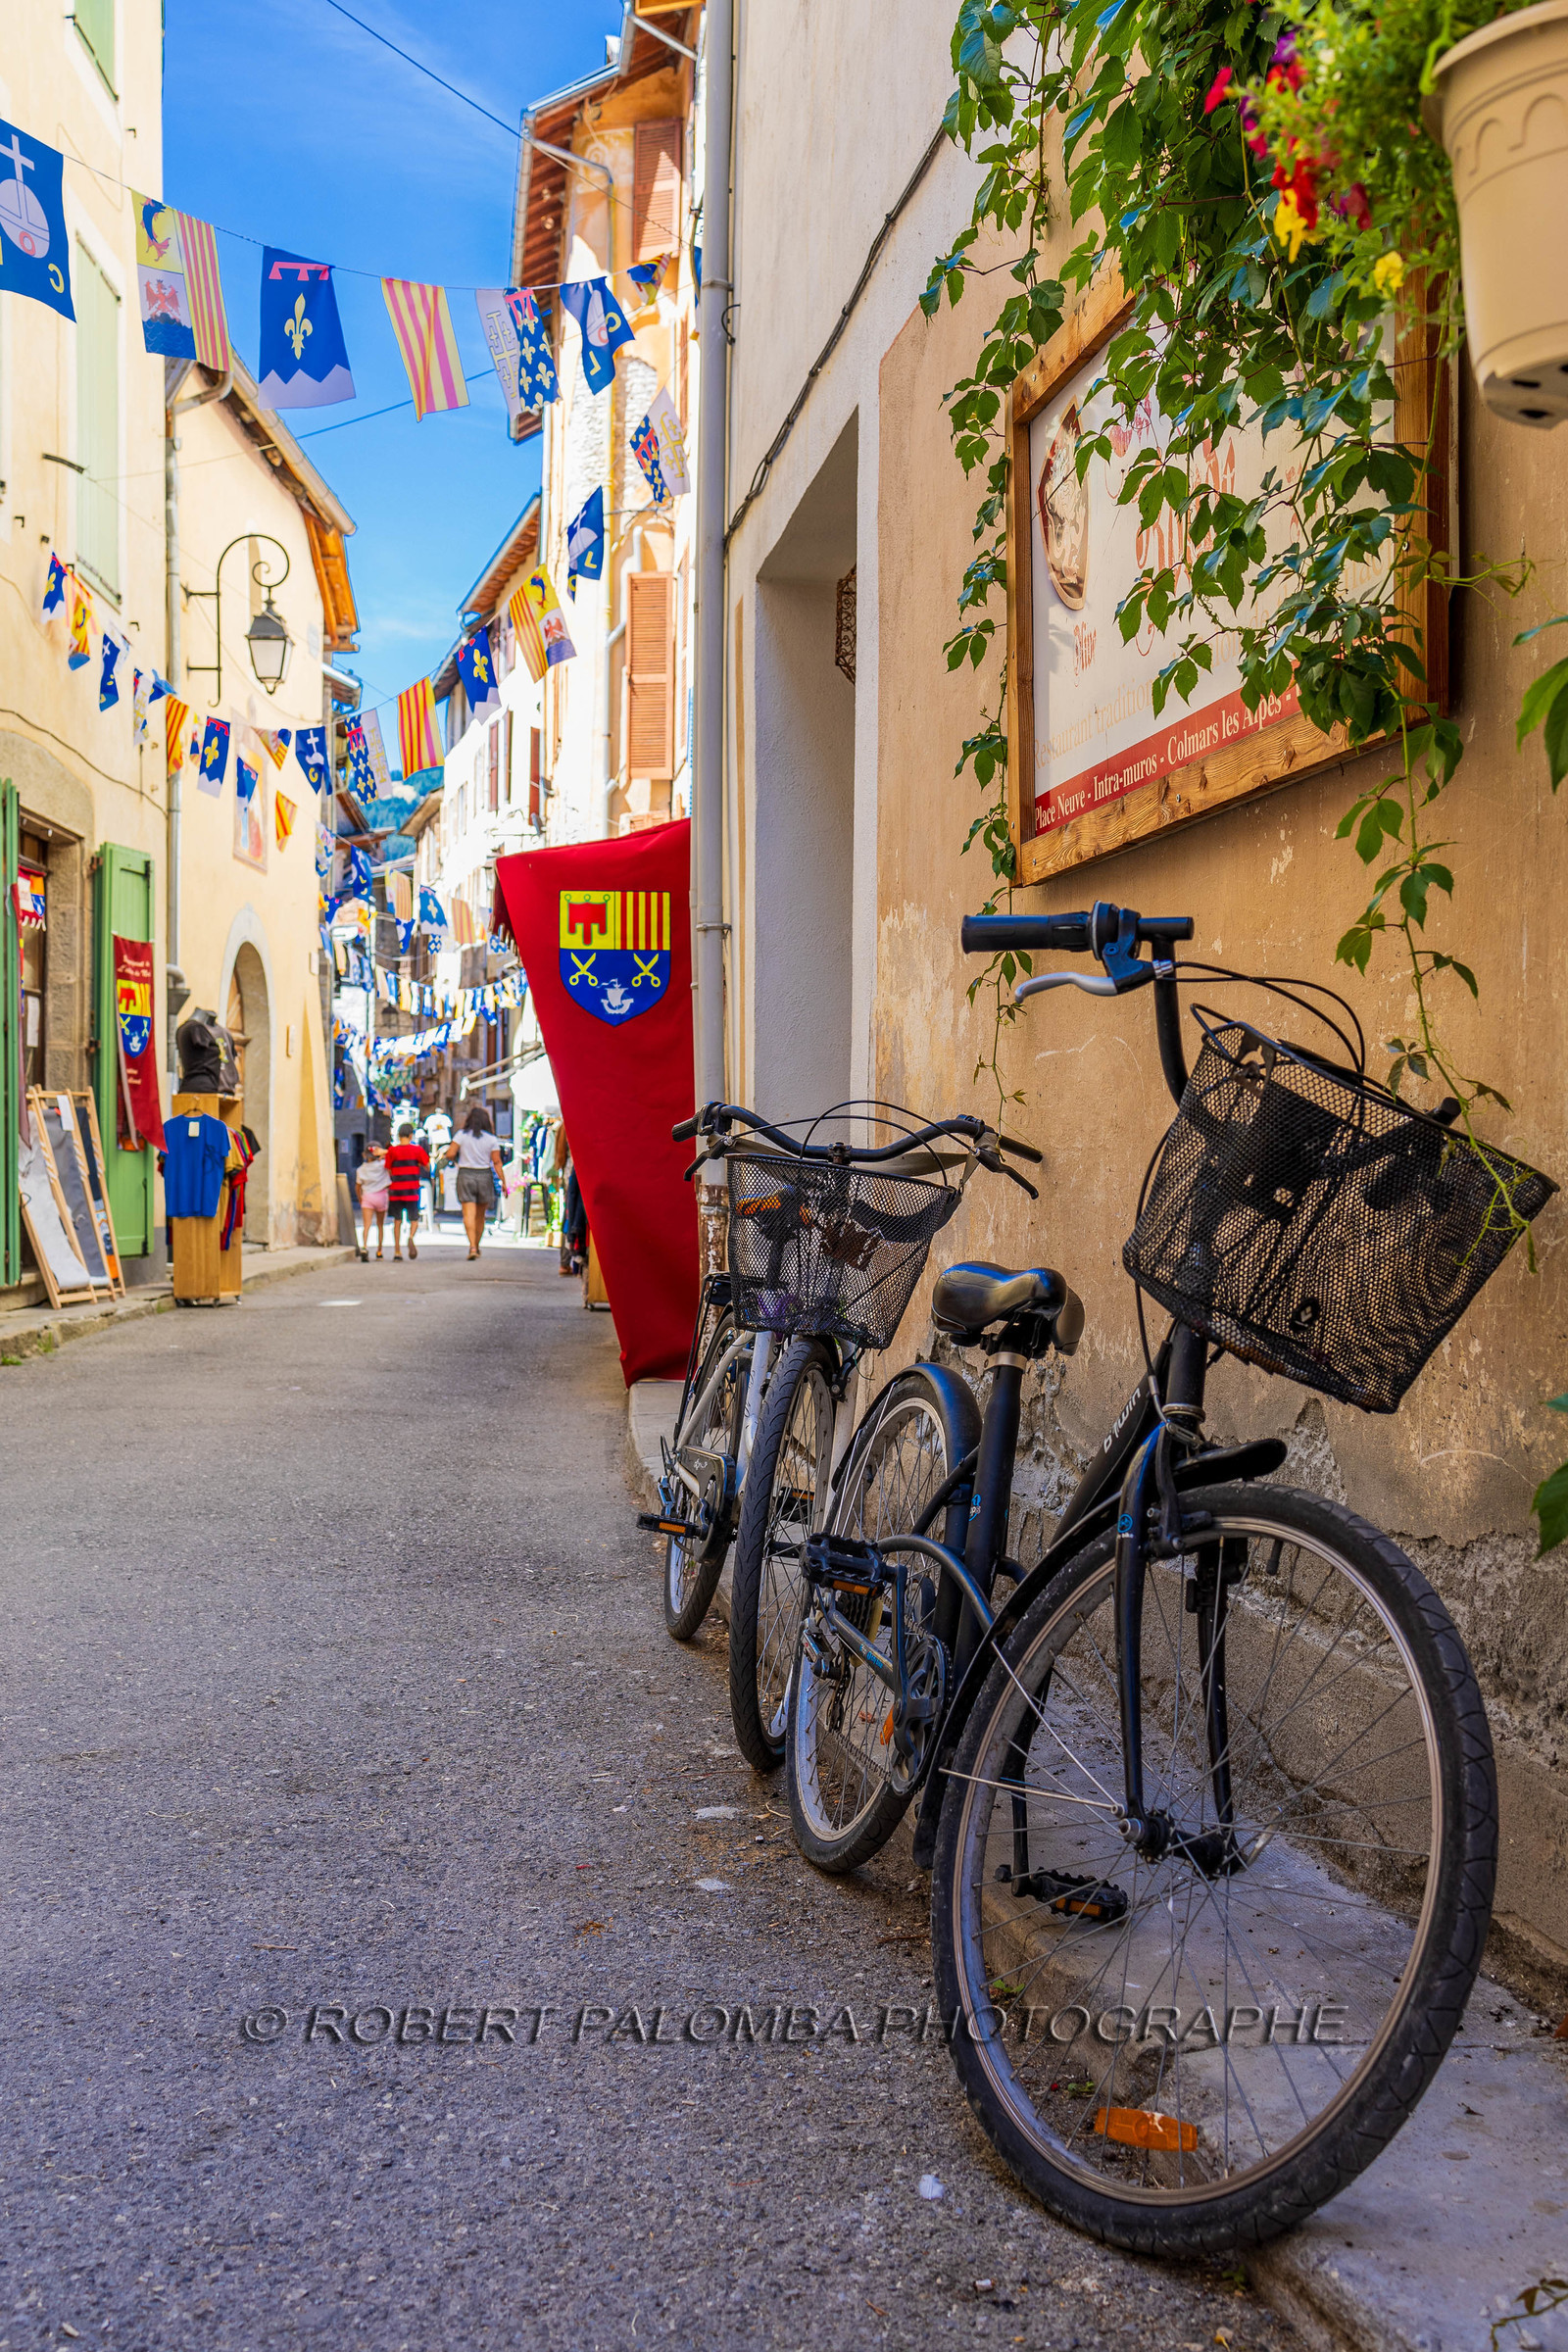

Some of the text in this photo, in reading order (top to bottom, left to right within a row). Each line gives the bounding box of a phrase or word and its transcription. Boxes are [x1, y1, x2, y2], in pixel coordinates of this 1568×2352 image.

[1035, 804, 1056, 831] Place
[1057, 790, 1086, 820] Neuve
[1094, 754, 1157, 802] Intra-muros
[1167, 721, 1219, 765] Colmars
[1222, 710, 1240, 740] les
